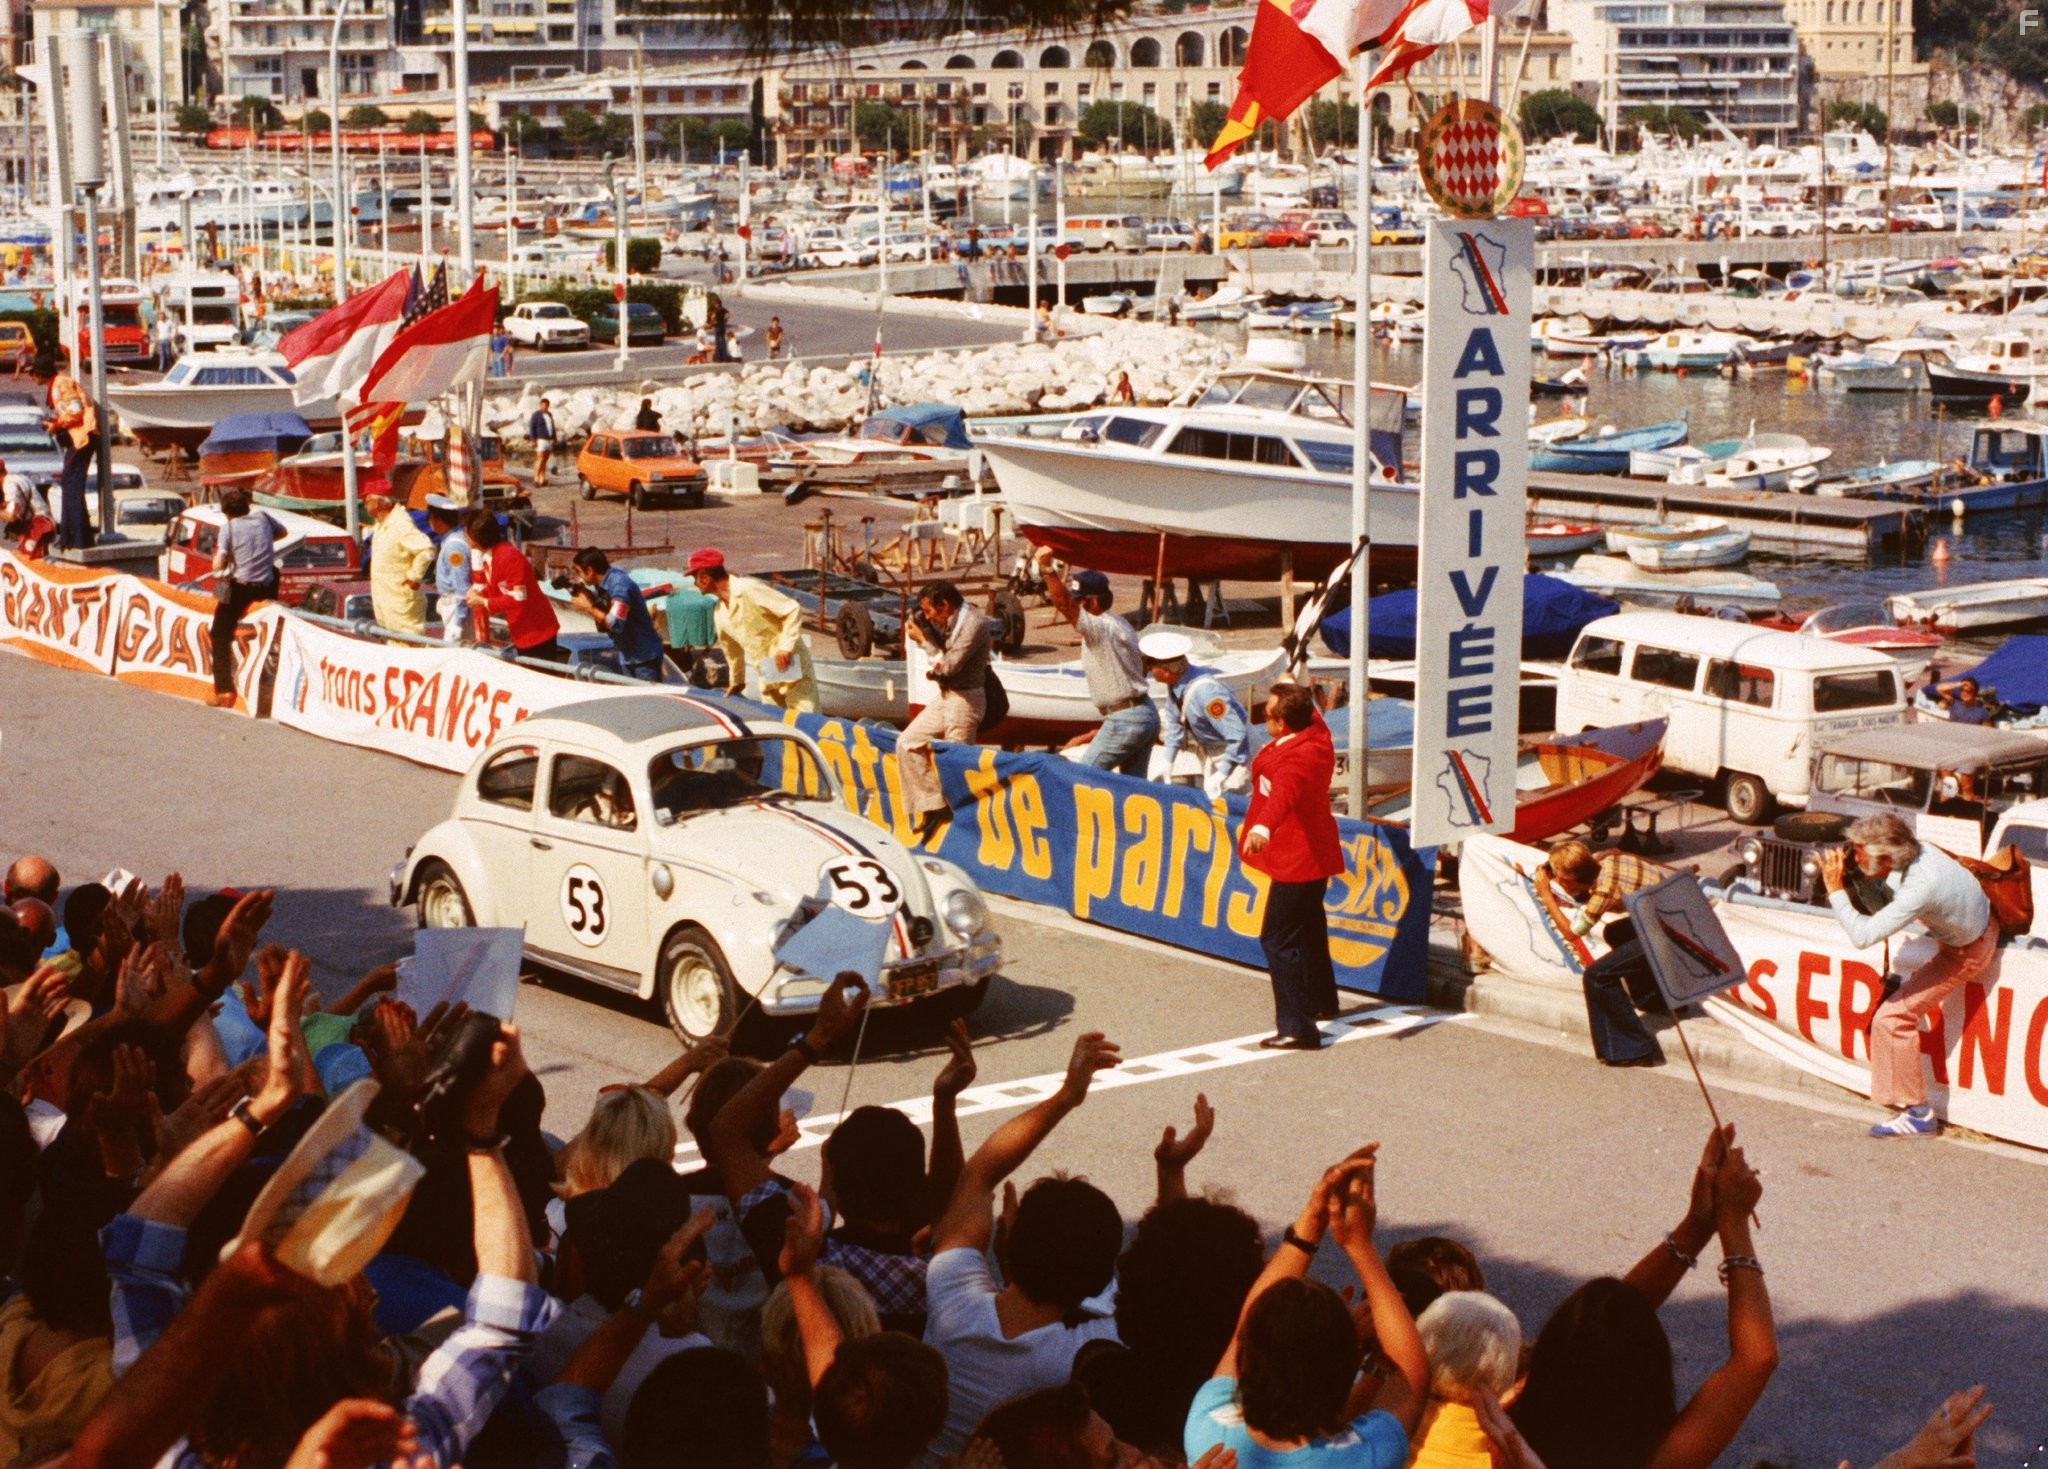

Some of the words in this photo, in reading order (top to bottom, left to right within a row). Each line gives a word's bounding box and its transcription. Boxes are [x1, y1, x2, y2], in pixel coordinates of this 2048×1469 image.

[1446, 327, 1505, 739] ARRIVÉE
[828, 861, 899, 909] 53
[964, 749, 1052, 880] de
[1073, 783, 1272, 938] paris
[568, 877, 606, 935] 53
